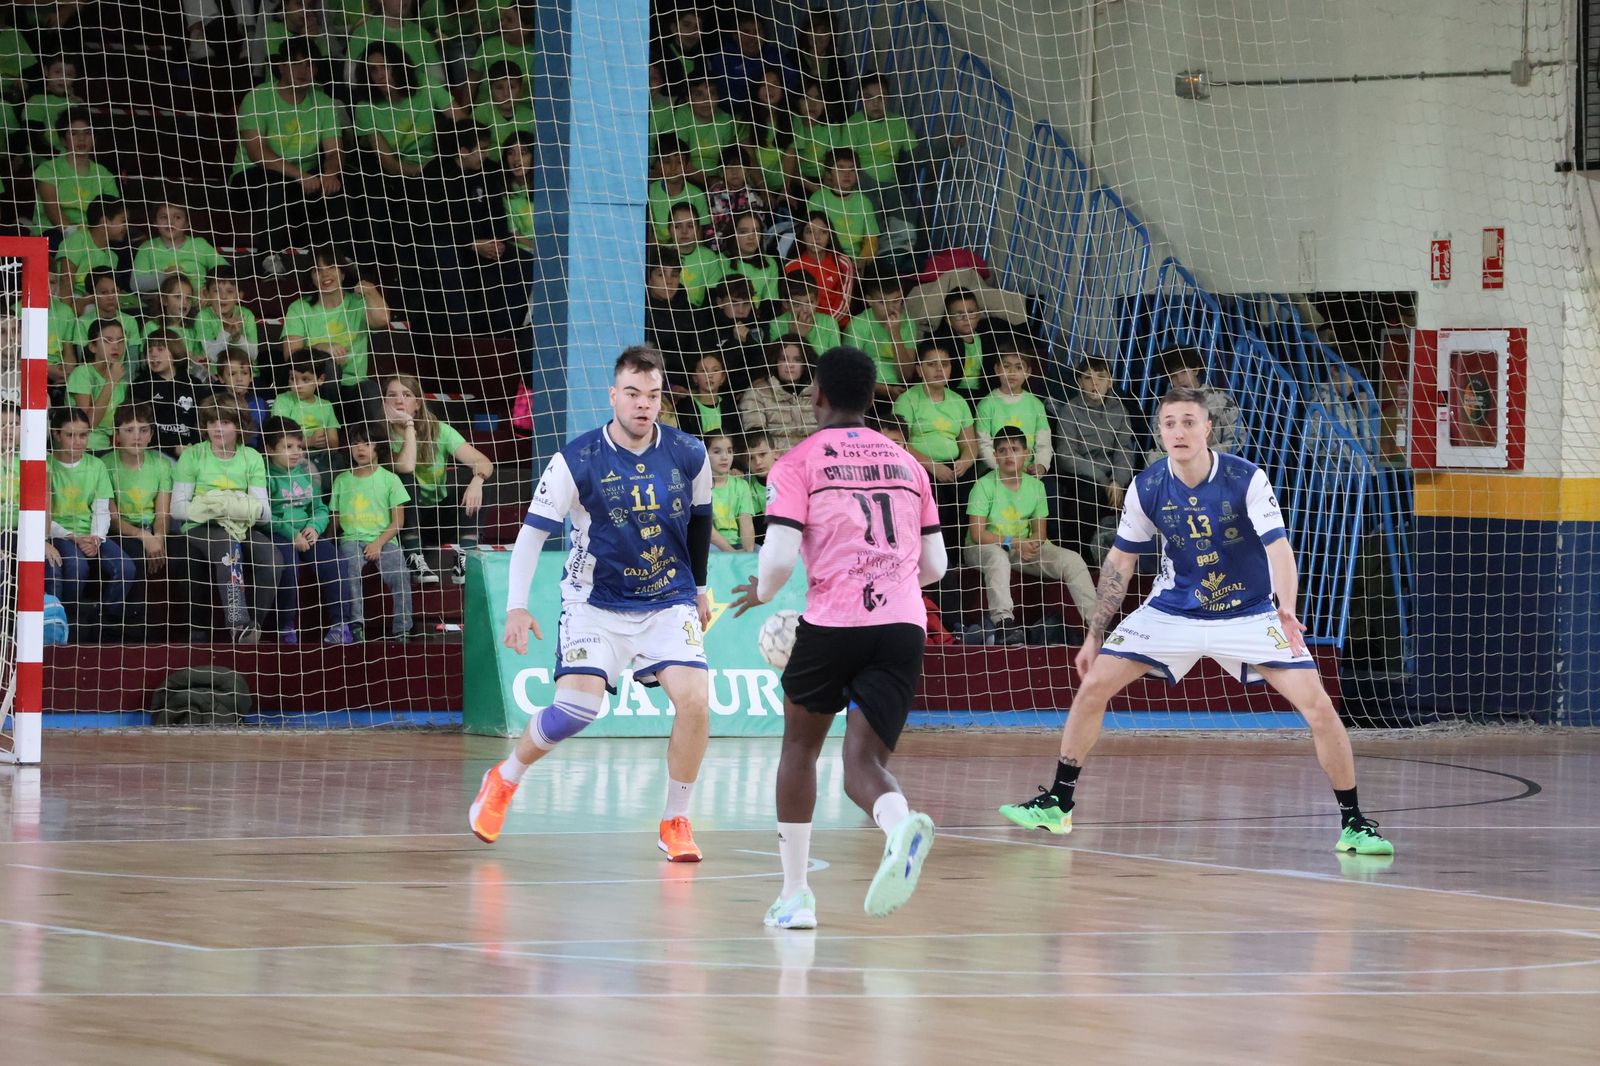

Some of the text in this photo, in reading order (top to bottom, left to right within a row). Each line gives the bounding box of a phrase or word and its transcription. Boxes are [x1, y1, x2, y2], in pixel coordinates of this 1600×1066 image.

[843, 449, 861, 458] Los
[823, 464, 881, 481] CRISTIAN
[631, 483, 661, 512] 11
[852, 492, 899, 550] 11
[1186, 514, 1213, 539] 13
[640, 524, 662, 541] gaza
[623, 567, 649, 577] CAJA
[651, 555, 679, 573] RURAL
[1196, 551, 1219, 567] gaza
[1212, 582, 1246, 599] RURAL
